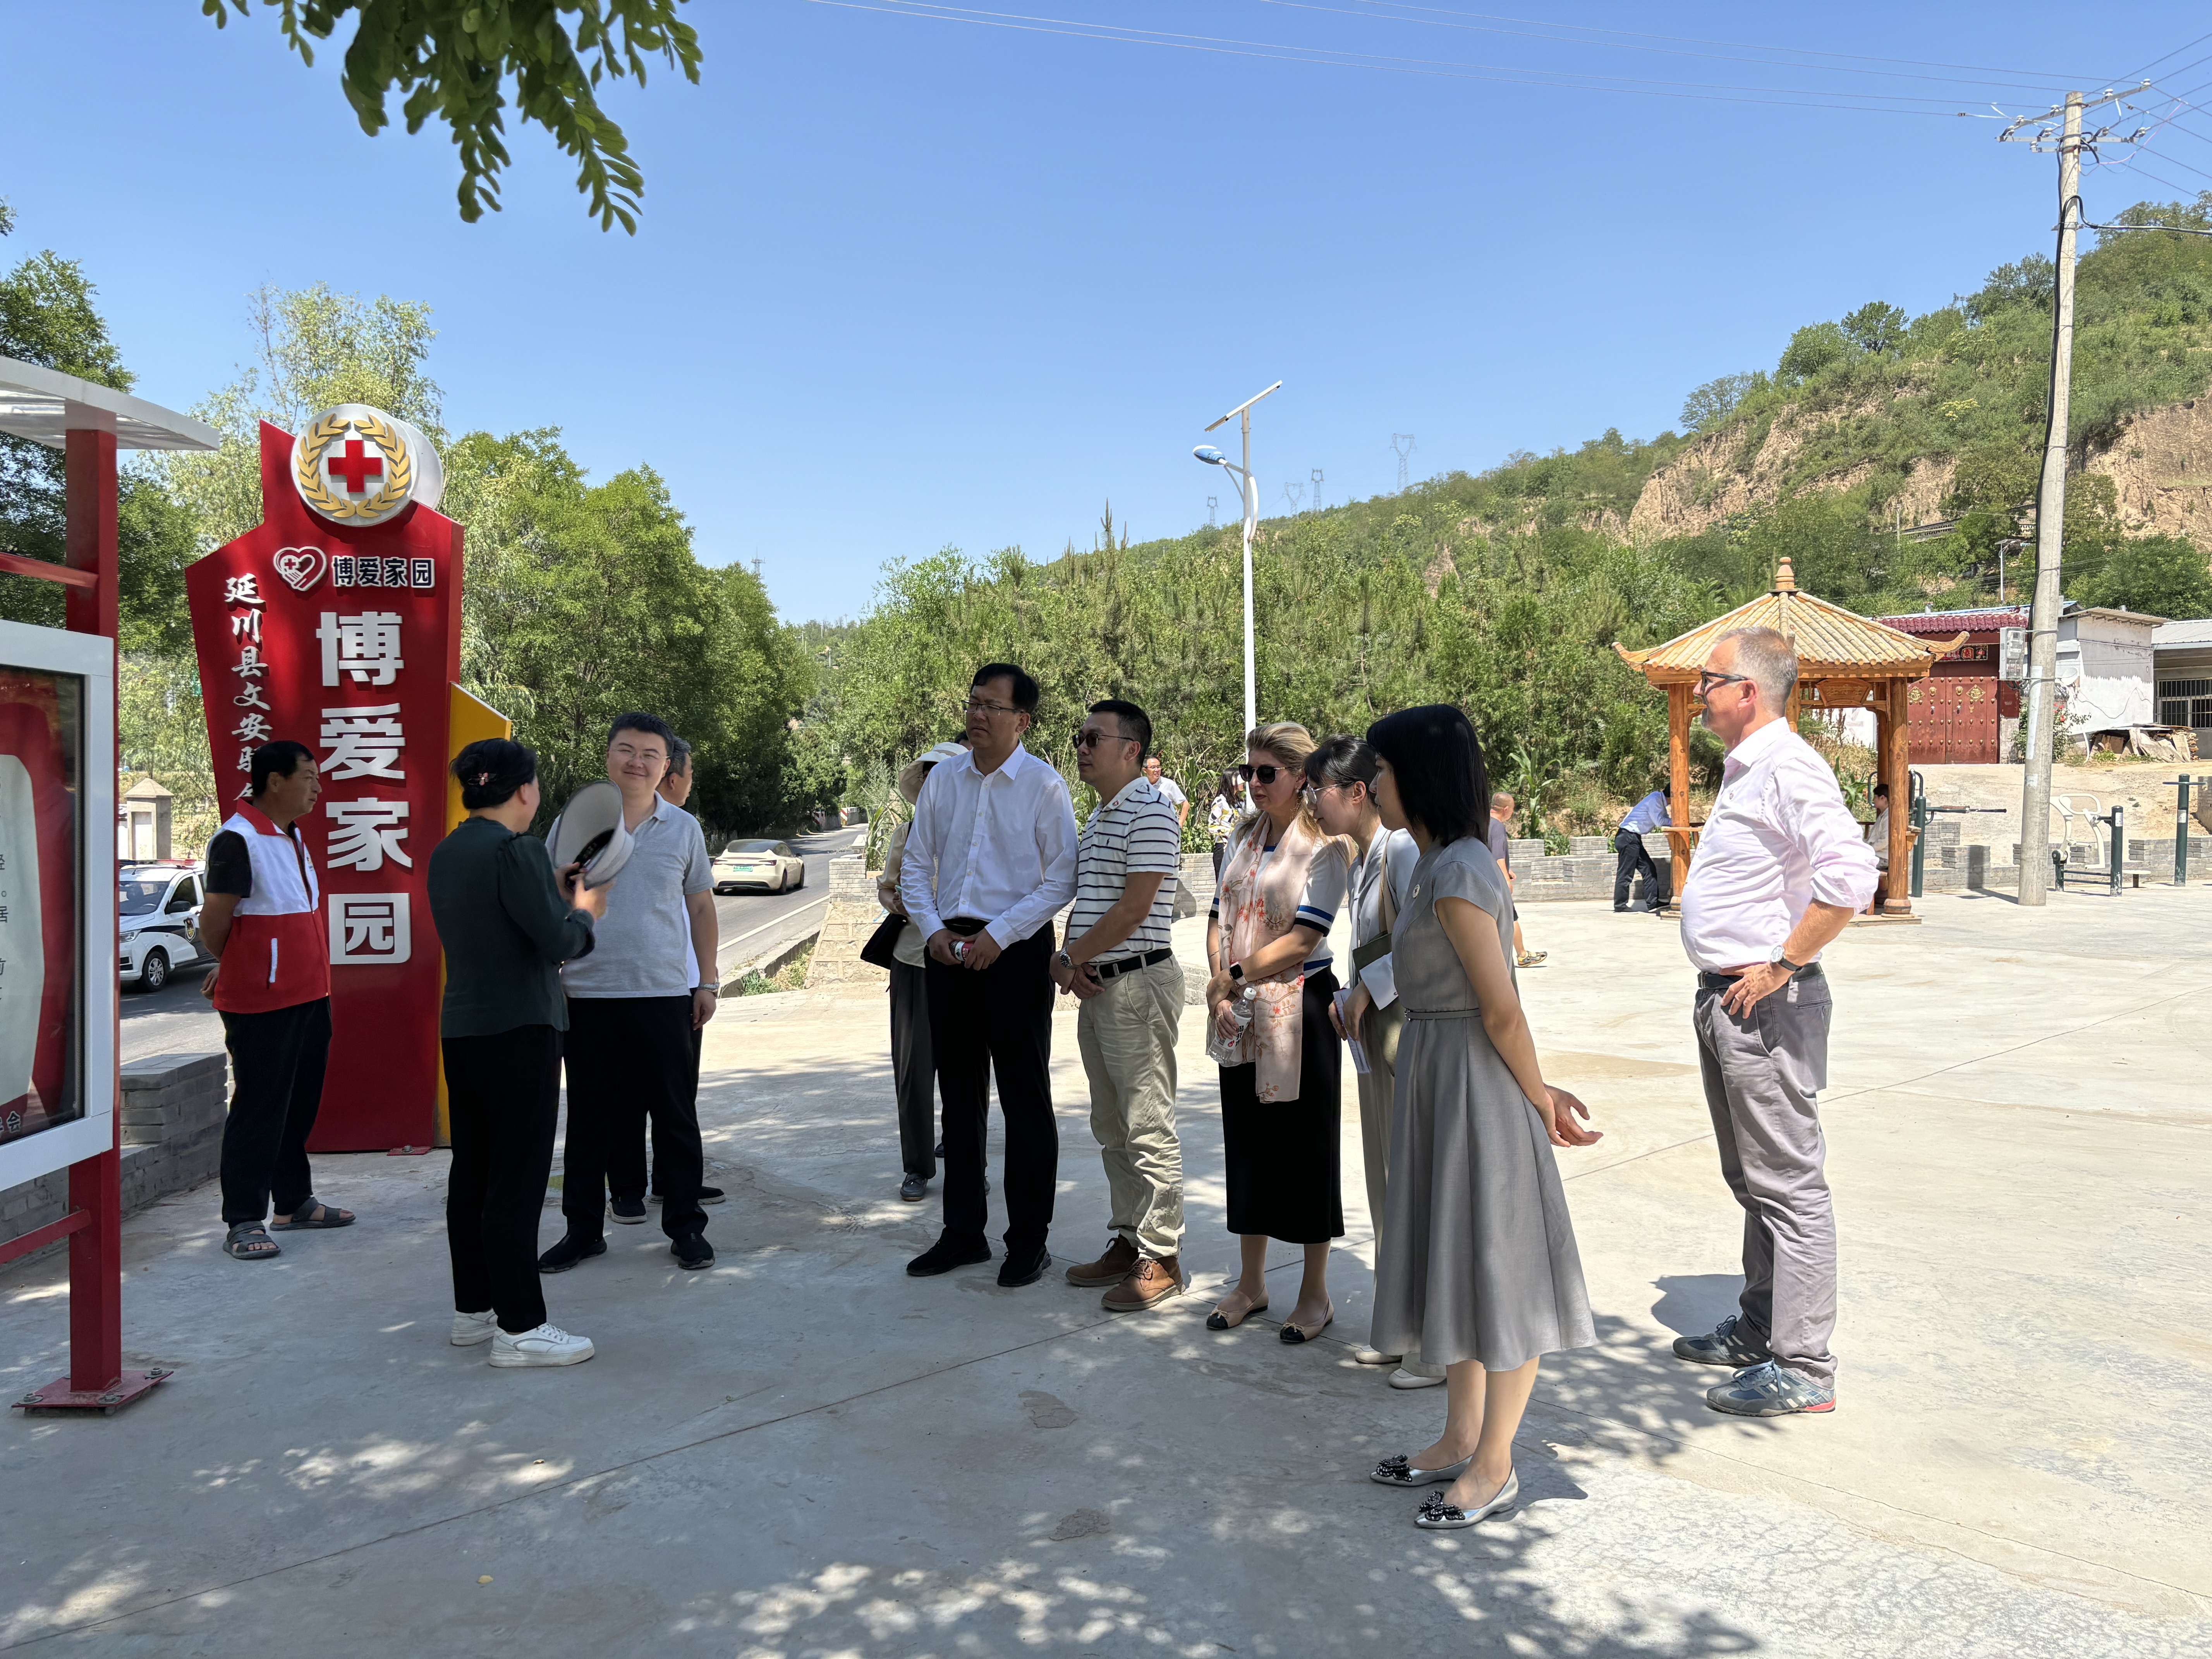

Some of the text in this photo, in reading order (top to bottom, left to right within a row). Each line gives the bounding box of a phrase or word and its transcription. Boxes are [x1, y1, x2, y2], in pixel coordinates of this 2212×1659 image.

[332, 555, 436, 589] 博爱家园
[224, 573, 273, 801] 延川县文安
[317, 611, 413, 964] 博爱家园
[0, 1111, 21, 1134] 会
